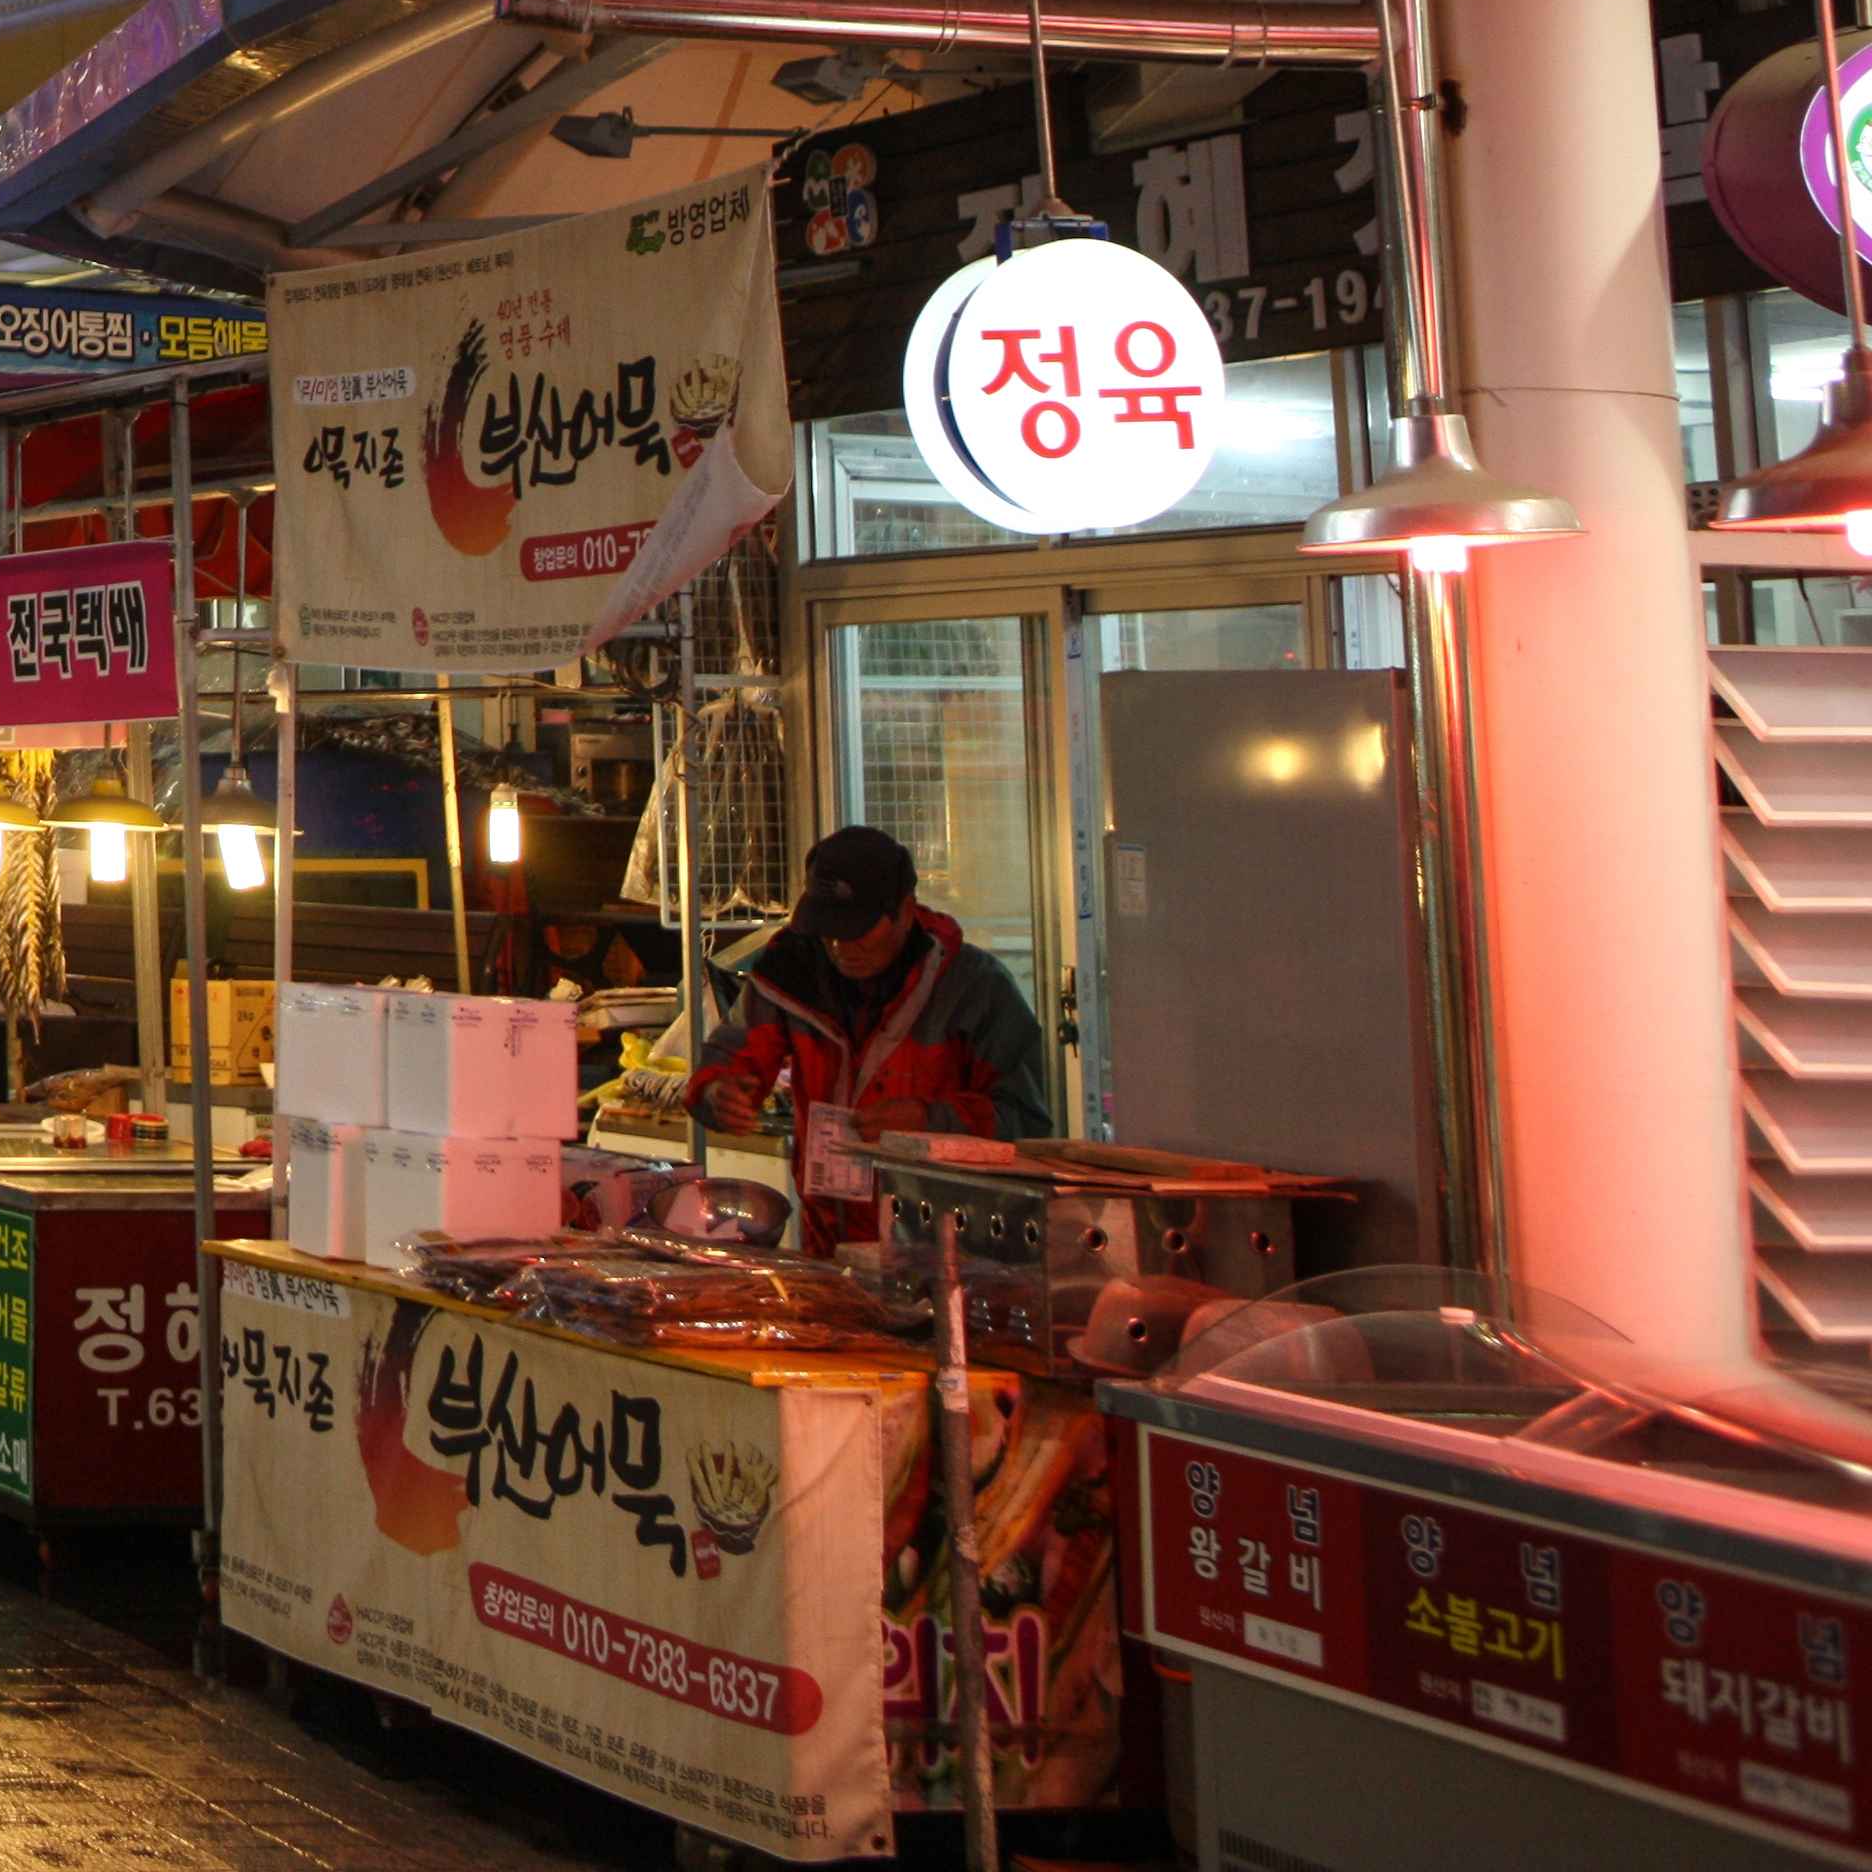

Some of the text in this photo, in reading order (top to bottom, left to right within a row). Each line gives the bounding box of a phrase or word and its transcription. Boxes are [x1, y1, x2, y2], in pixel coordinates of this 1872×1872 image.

[666, 183, 753, 247] 방영업체
[159, 315, 268, 360] 모듬해물
[497, 294, 523, 322] 40년
[499, 315, 571, 360] 명품 수제
[479, 354, 673, 501] 부산어묵
[981, 321, 1203, 459] 정육
[303, 424, 405, 490] 어묵지존
[532, 540, 579, 572] 창업문의
[7, 579, 149, 681] 전국택배
[427, 1334, 688, 1580] 부산어묵
[1186, 1525, 1323, 1612] 왕갈비
[483, 1579, 556, 1640] 창업문의
[563, 1605, 781, 1725] 010-7383-6337
[1406, 1587, 1566, 1682] 소불고기
[1661, 1658, 1852, 1768] 돼지갈비
